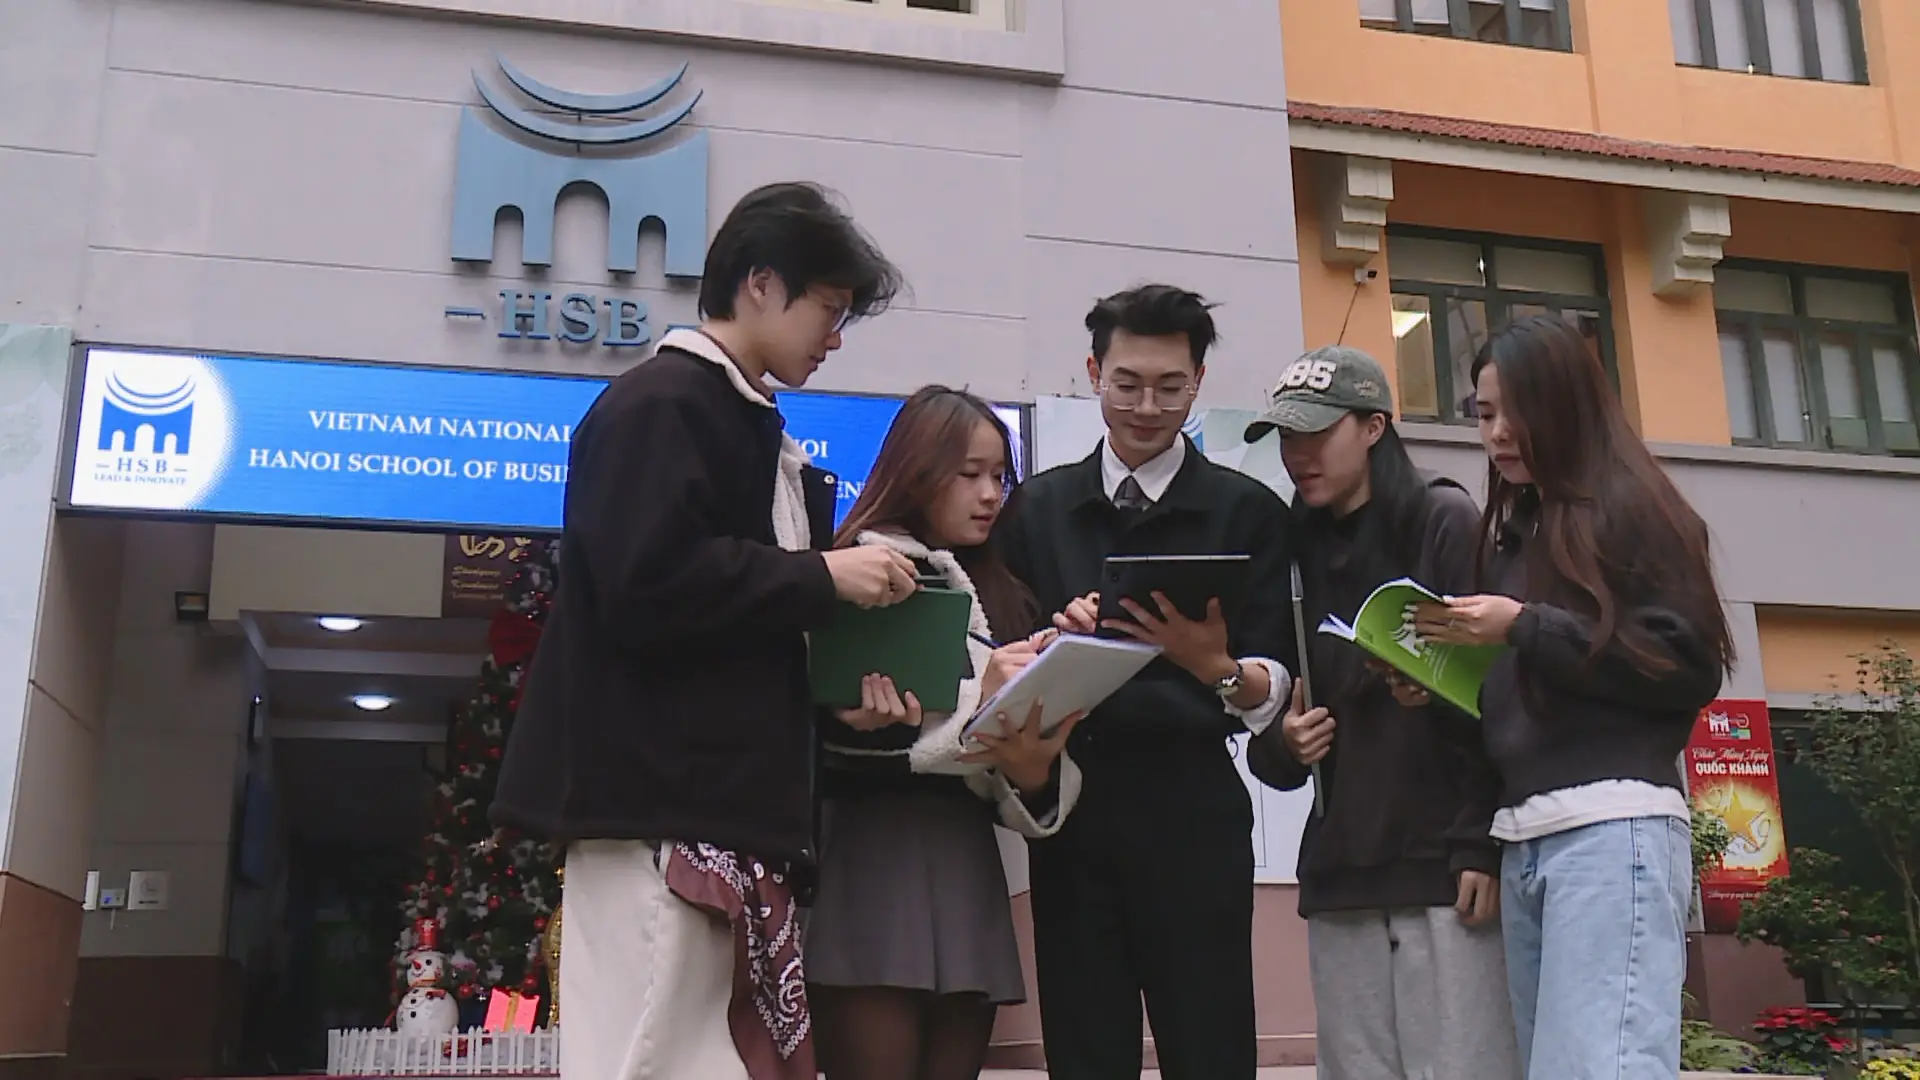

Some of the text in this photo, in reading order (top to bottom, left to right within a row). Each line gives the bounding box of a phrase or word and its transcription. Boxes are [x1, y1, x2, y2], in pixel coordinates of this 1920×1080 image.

[498, 289, 651, 347] HSB
[309, 410, 432, 436] VIETNAM
[794, 438, 828, 458] OI
[94, 473, 122, 482] LEAD
[134, 475, 186, 485] INNOVATE
[117, 457, 168, 473] HSB
[249, 448, 340, 472] HANOI
[347, 453, 457, 478] SCHOOL
[463, 460, 498, 480] OF
